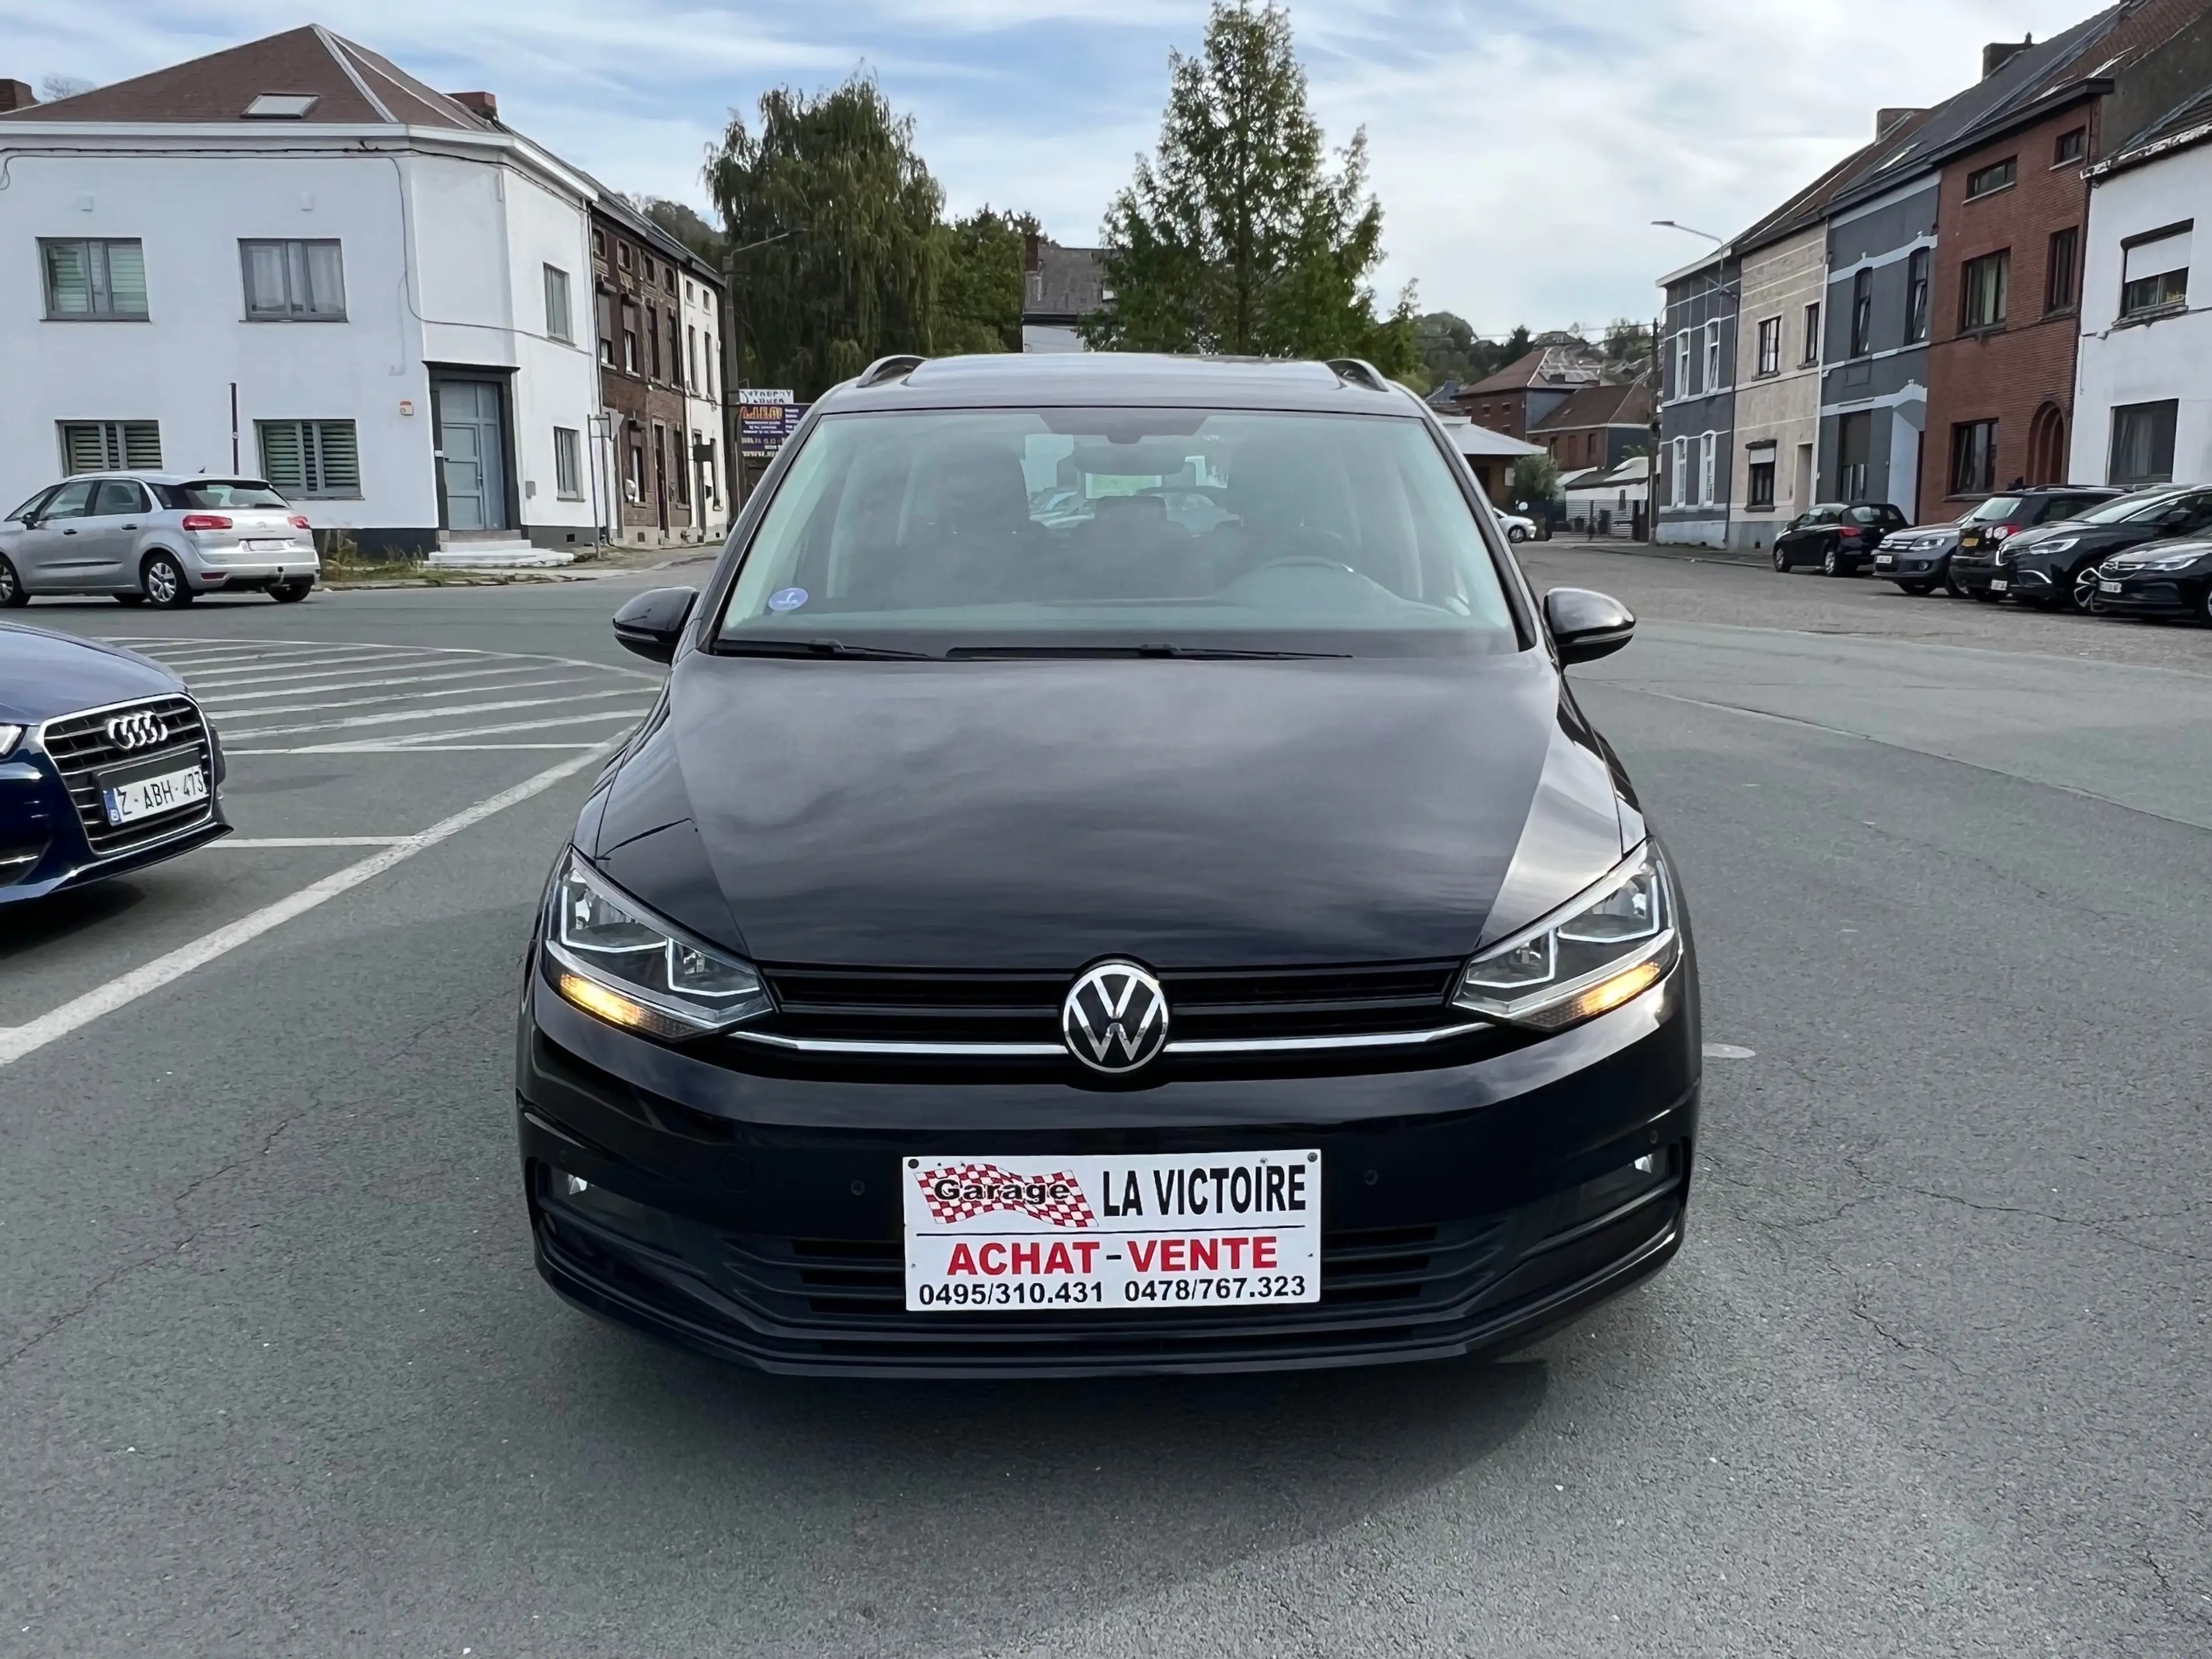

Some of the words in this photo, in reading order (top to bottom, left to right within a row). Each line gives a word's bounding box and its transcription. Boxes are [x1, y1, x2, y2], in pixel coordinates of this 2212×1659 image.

[934, 1180, 1069, 1205] Garage
[1103, 1170, 1143, 1217] LA
[1153, 1165, 1306, 1215] VICTOIRE
[919, 1282, 1102, 1305] 0495/310.431
[1125, 1275, 1306, 1302] 0478/767.323
